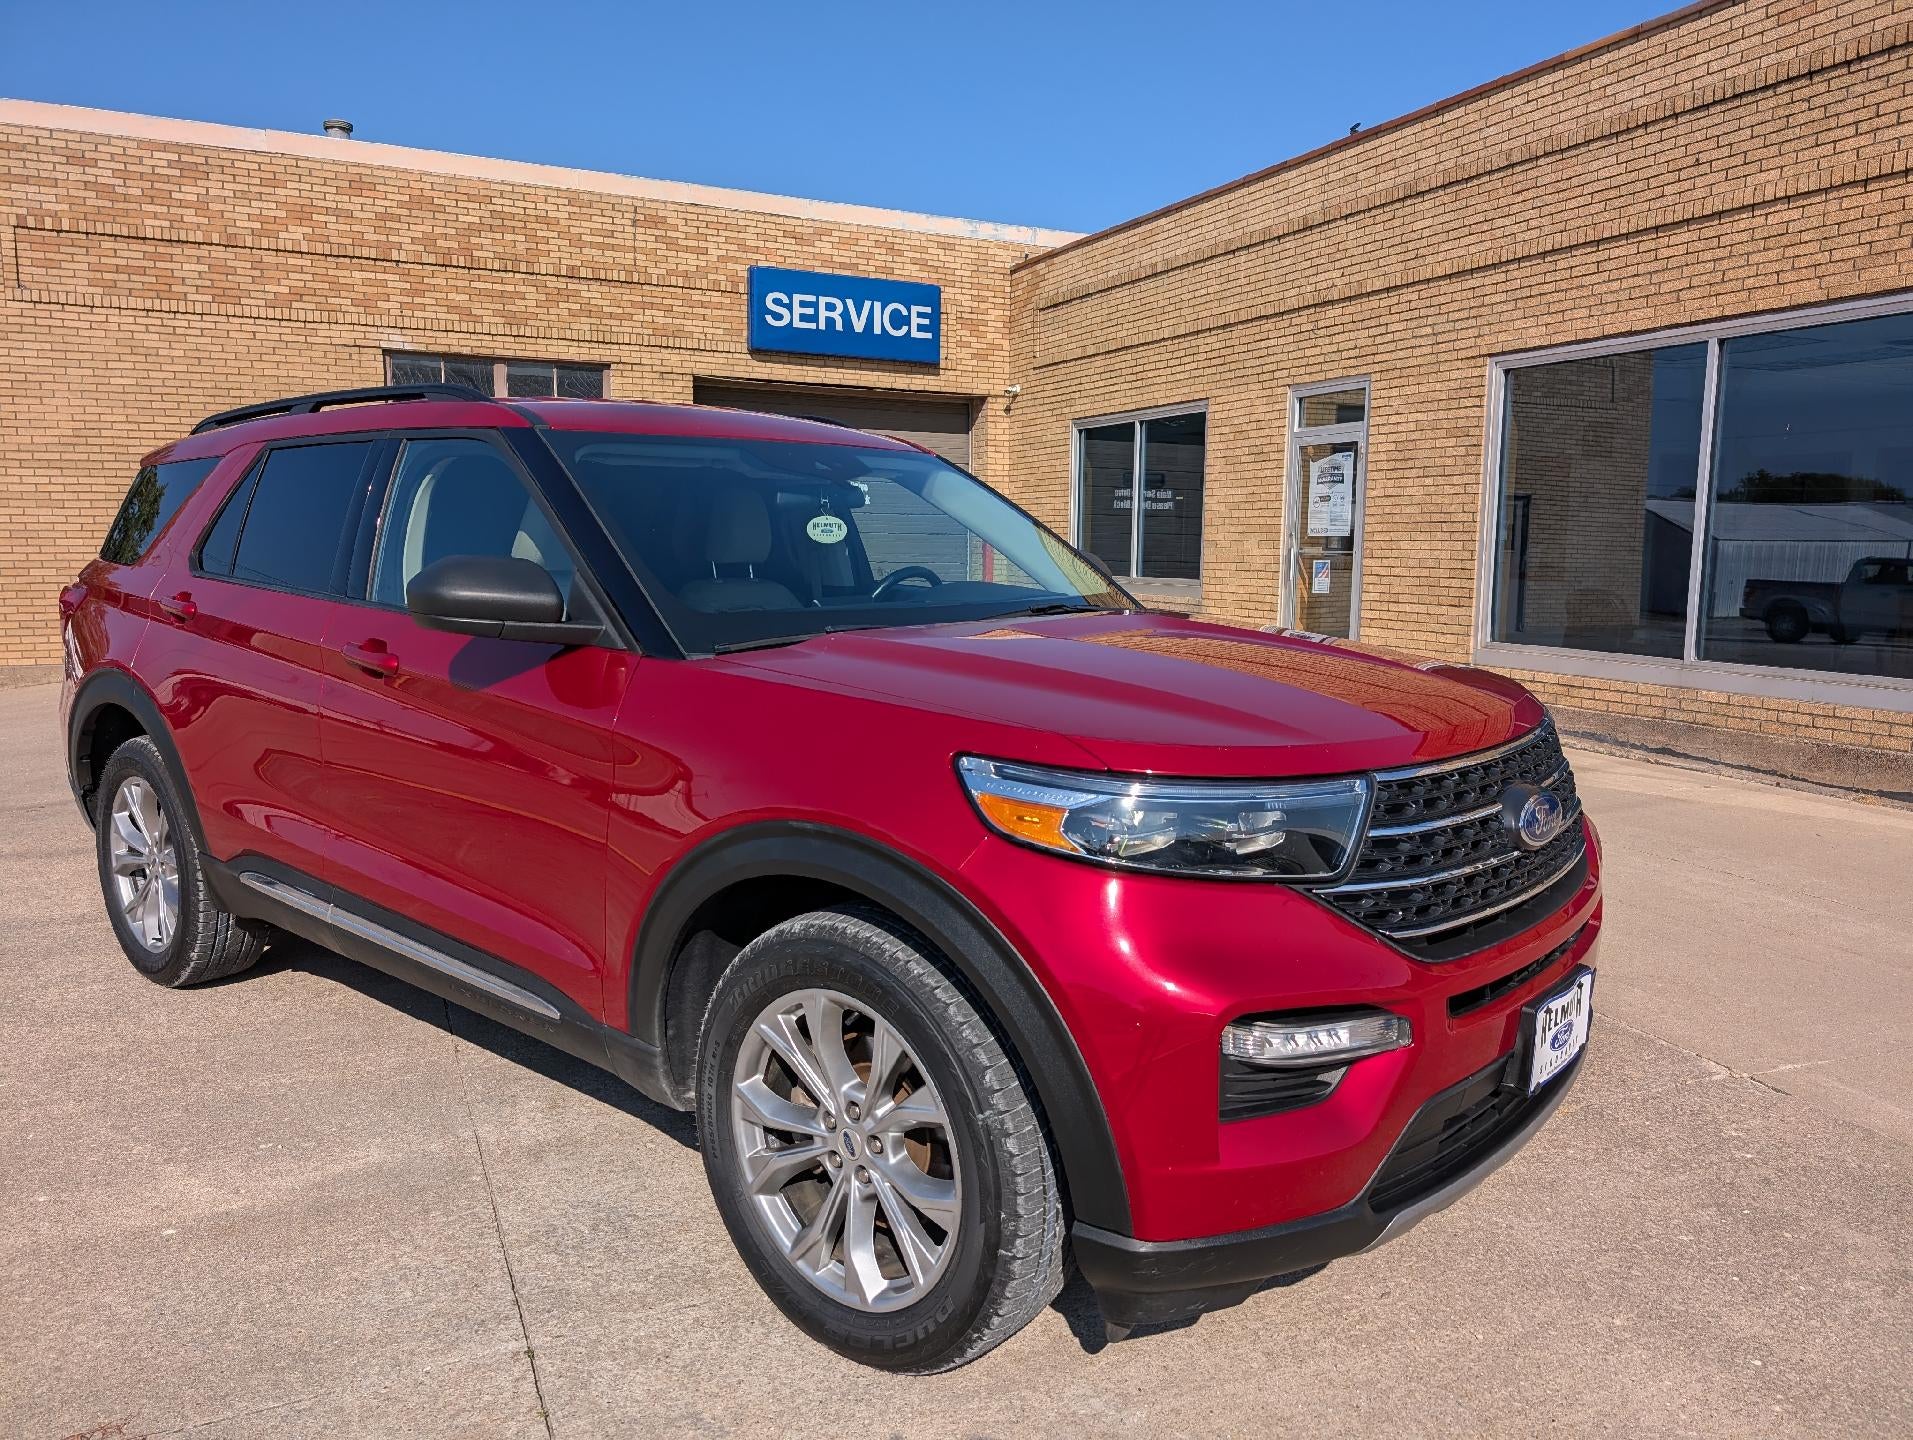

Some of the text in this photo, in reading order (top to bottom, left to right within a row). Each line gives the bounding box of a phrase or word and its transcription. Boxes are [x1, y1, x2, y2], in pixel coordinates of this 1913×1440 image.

[764, 291, 933, 339] SERVICE
[1320, 465, 1342, 473] LIFETIME
[812, 522, 842, 531] HELMUTH
[1535, 804, 1558, 836] Ford
